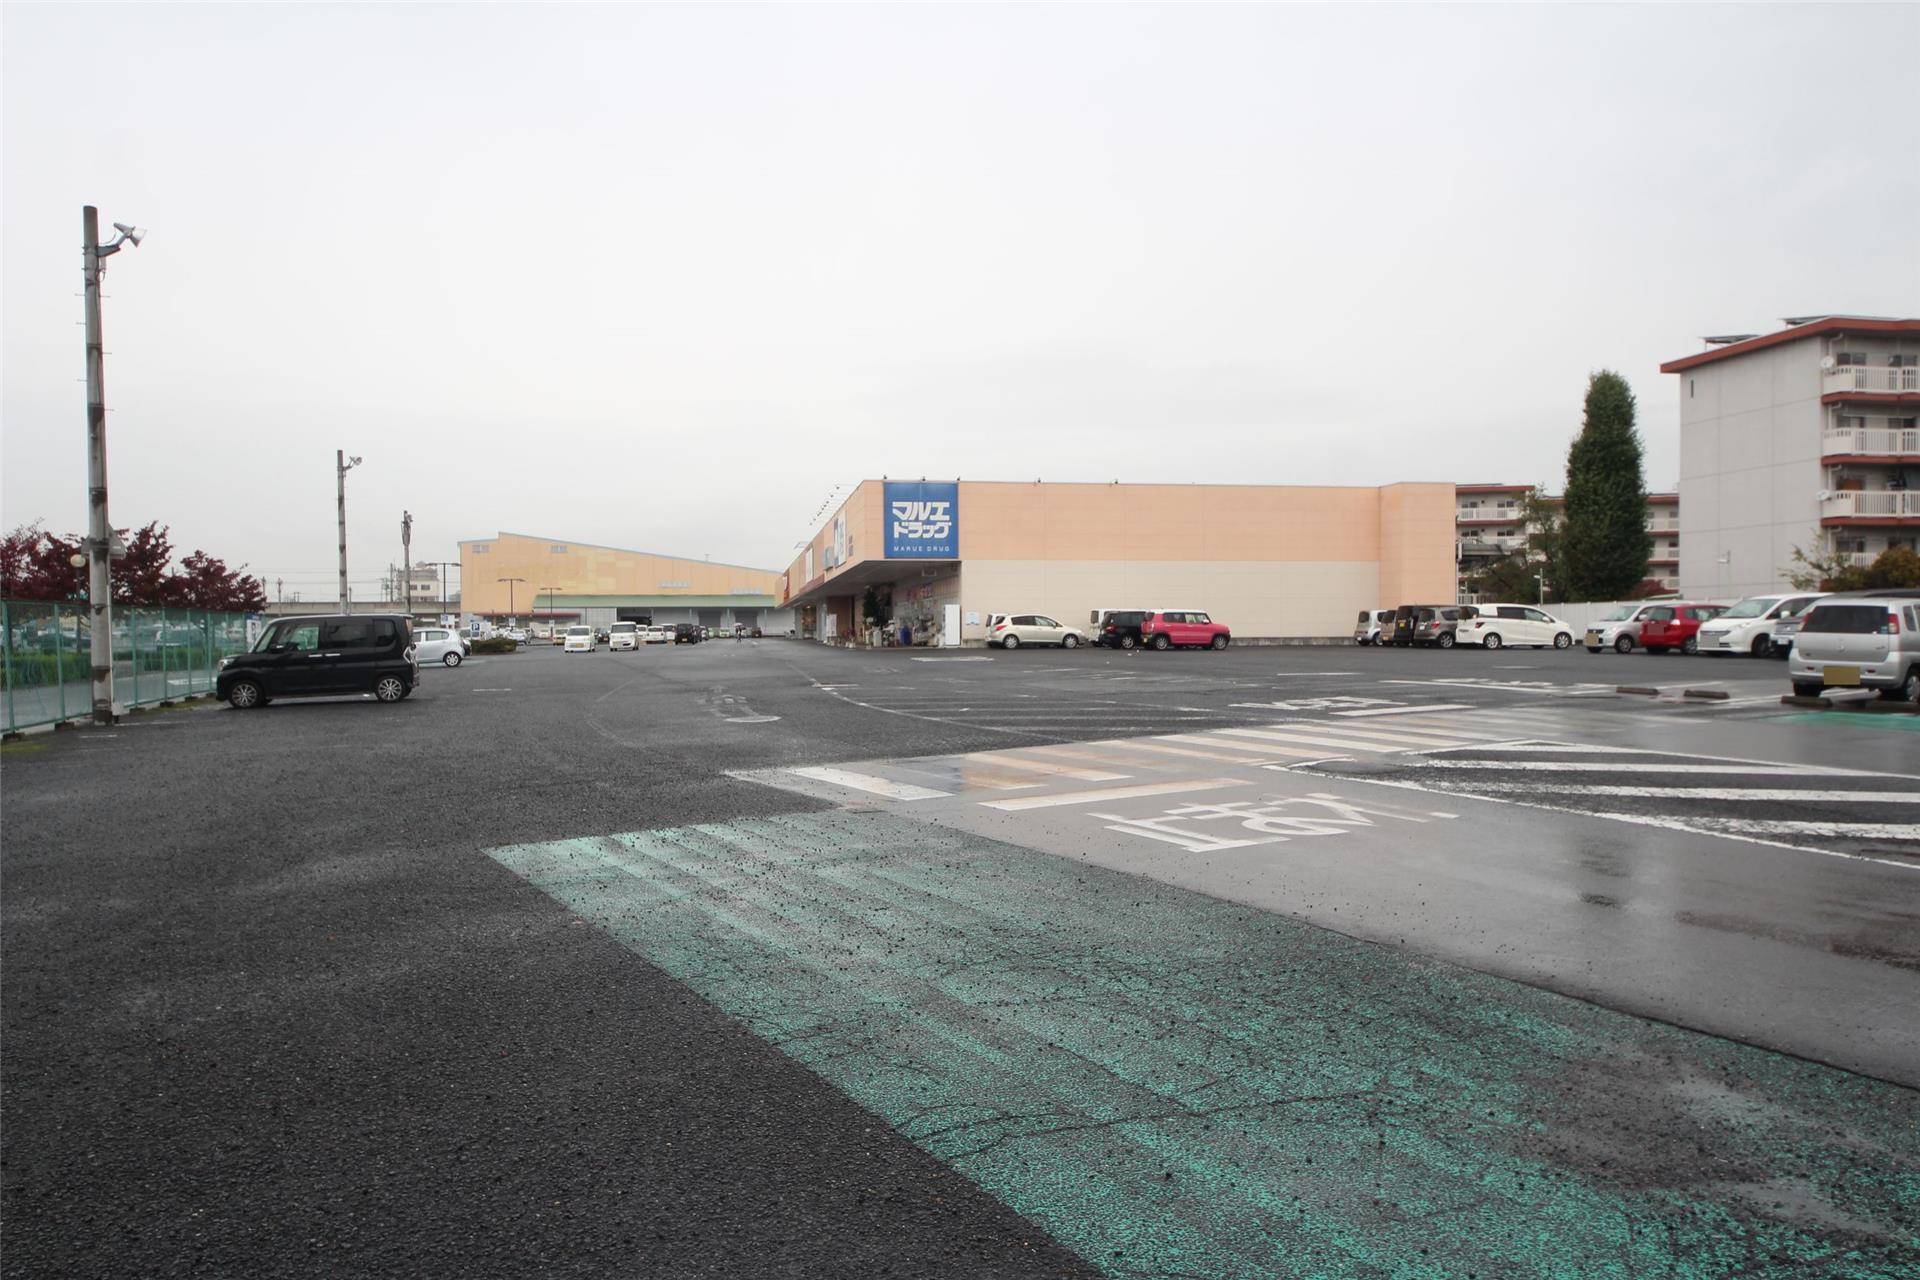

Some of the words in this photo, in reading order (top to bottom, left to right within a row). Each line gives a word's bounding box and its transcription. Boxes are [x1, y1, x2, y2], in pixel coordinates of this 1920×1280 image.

[892, 501, 950, 521] マルエ
[893, 521, 952, 539] ドラッグ
